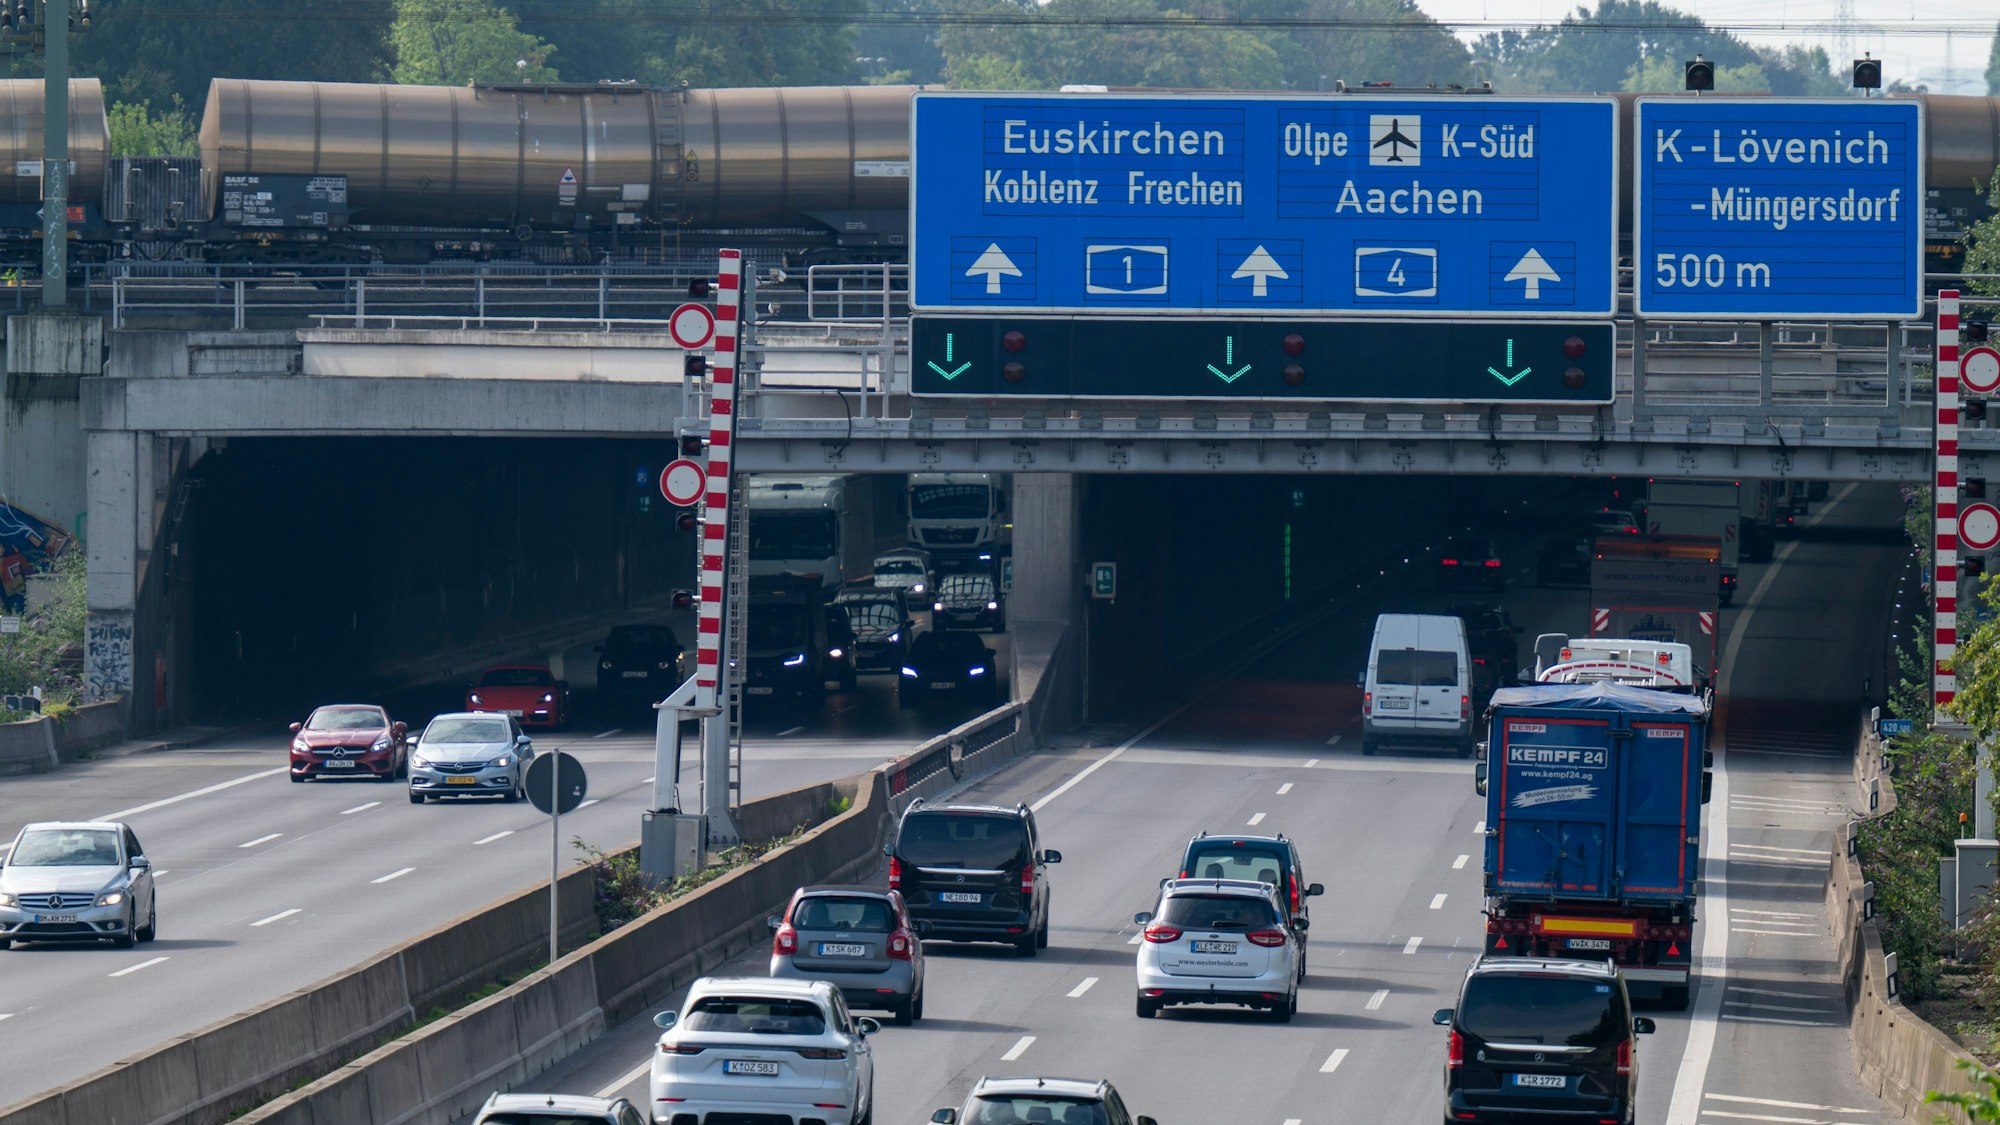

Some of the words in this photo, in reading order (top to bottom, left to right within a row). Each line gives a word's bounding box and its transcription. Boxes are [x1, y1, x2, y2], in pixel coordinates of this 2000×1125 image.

[1004, 119, 1224, 156] Euskirchen
[1284, 122, 1348, 166] Olpe
[1442, 123, 1534, 159] K-Süd
[1657, 128, 1888, 164] K-Lövenich
[247, 176, 259, 184] SE
[985, 169, 1099, 205] Koblenz
[1128, 171, 1243, 206] Frechen
[1335, 180, 1483, 215] Aachen
[1691, 187, 1901, 231] -Müngersdorf
[1122, 255, 1132, 284] 1
[1387, 258, 1406, 286] 4
[1657, 253, 1725, 288] 500
[1736, 262, 1771, 288] m
[1883, 722, 1898, 732] 420
[1511, 748, 1581, 763] KEMPF
[1583, 751, 1604, 764] 24
[1521, 770, 1593, 781] www.kempf24.ag
[1524, 786, 1582, 798] Muldenvermietung
[969, 894, 978, 902] 94
[825, 944, 831, 952] K
[836, 945, 846, 953] SK
[1195, 942, 1208, 950] KLE
[1213, 943, 1222, 951] WE
[1178, 959, 1249, 967] www.westerheide.com
[732, 1062, 738, 1071] K
[757, 1063, 774, 1073] 583
[1520, 1075, 1526, 1084] K
[1532, 1076, 1538, 1085] R
[1540, 1076, 1562, 1086] 1772
